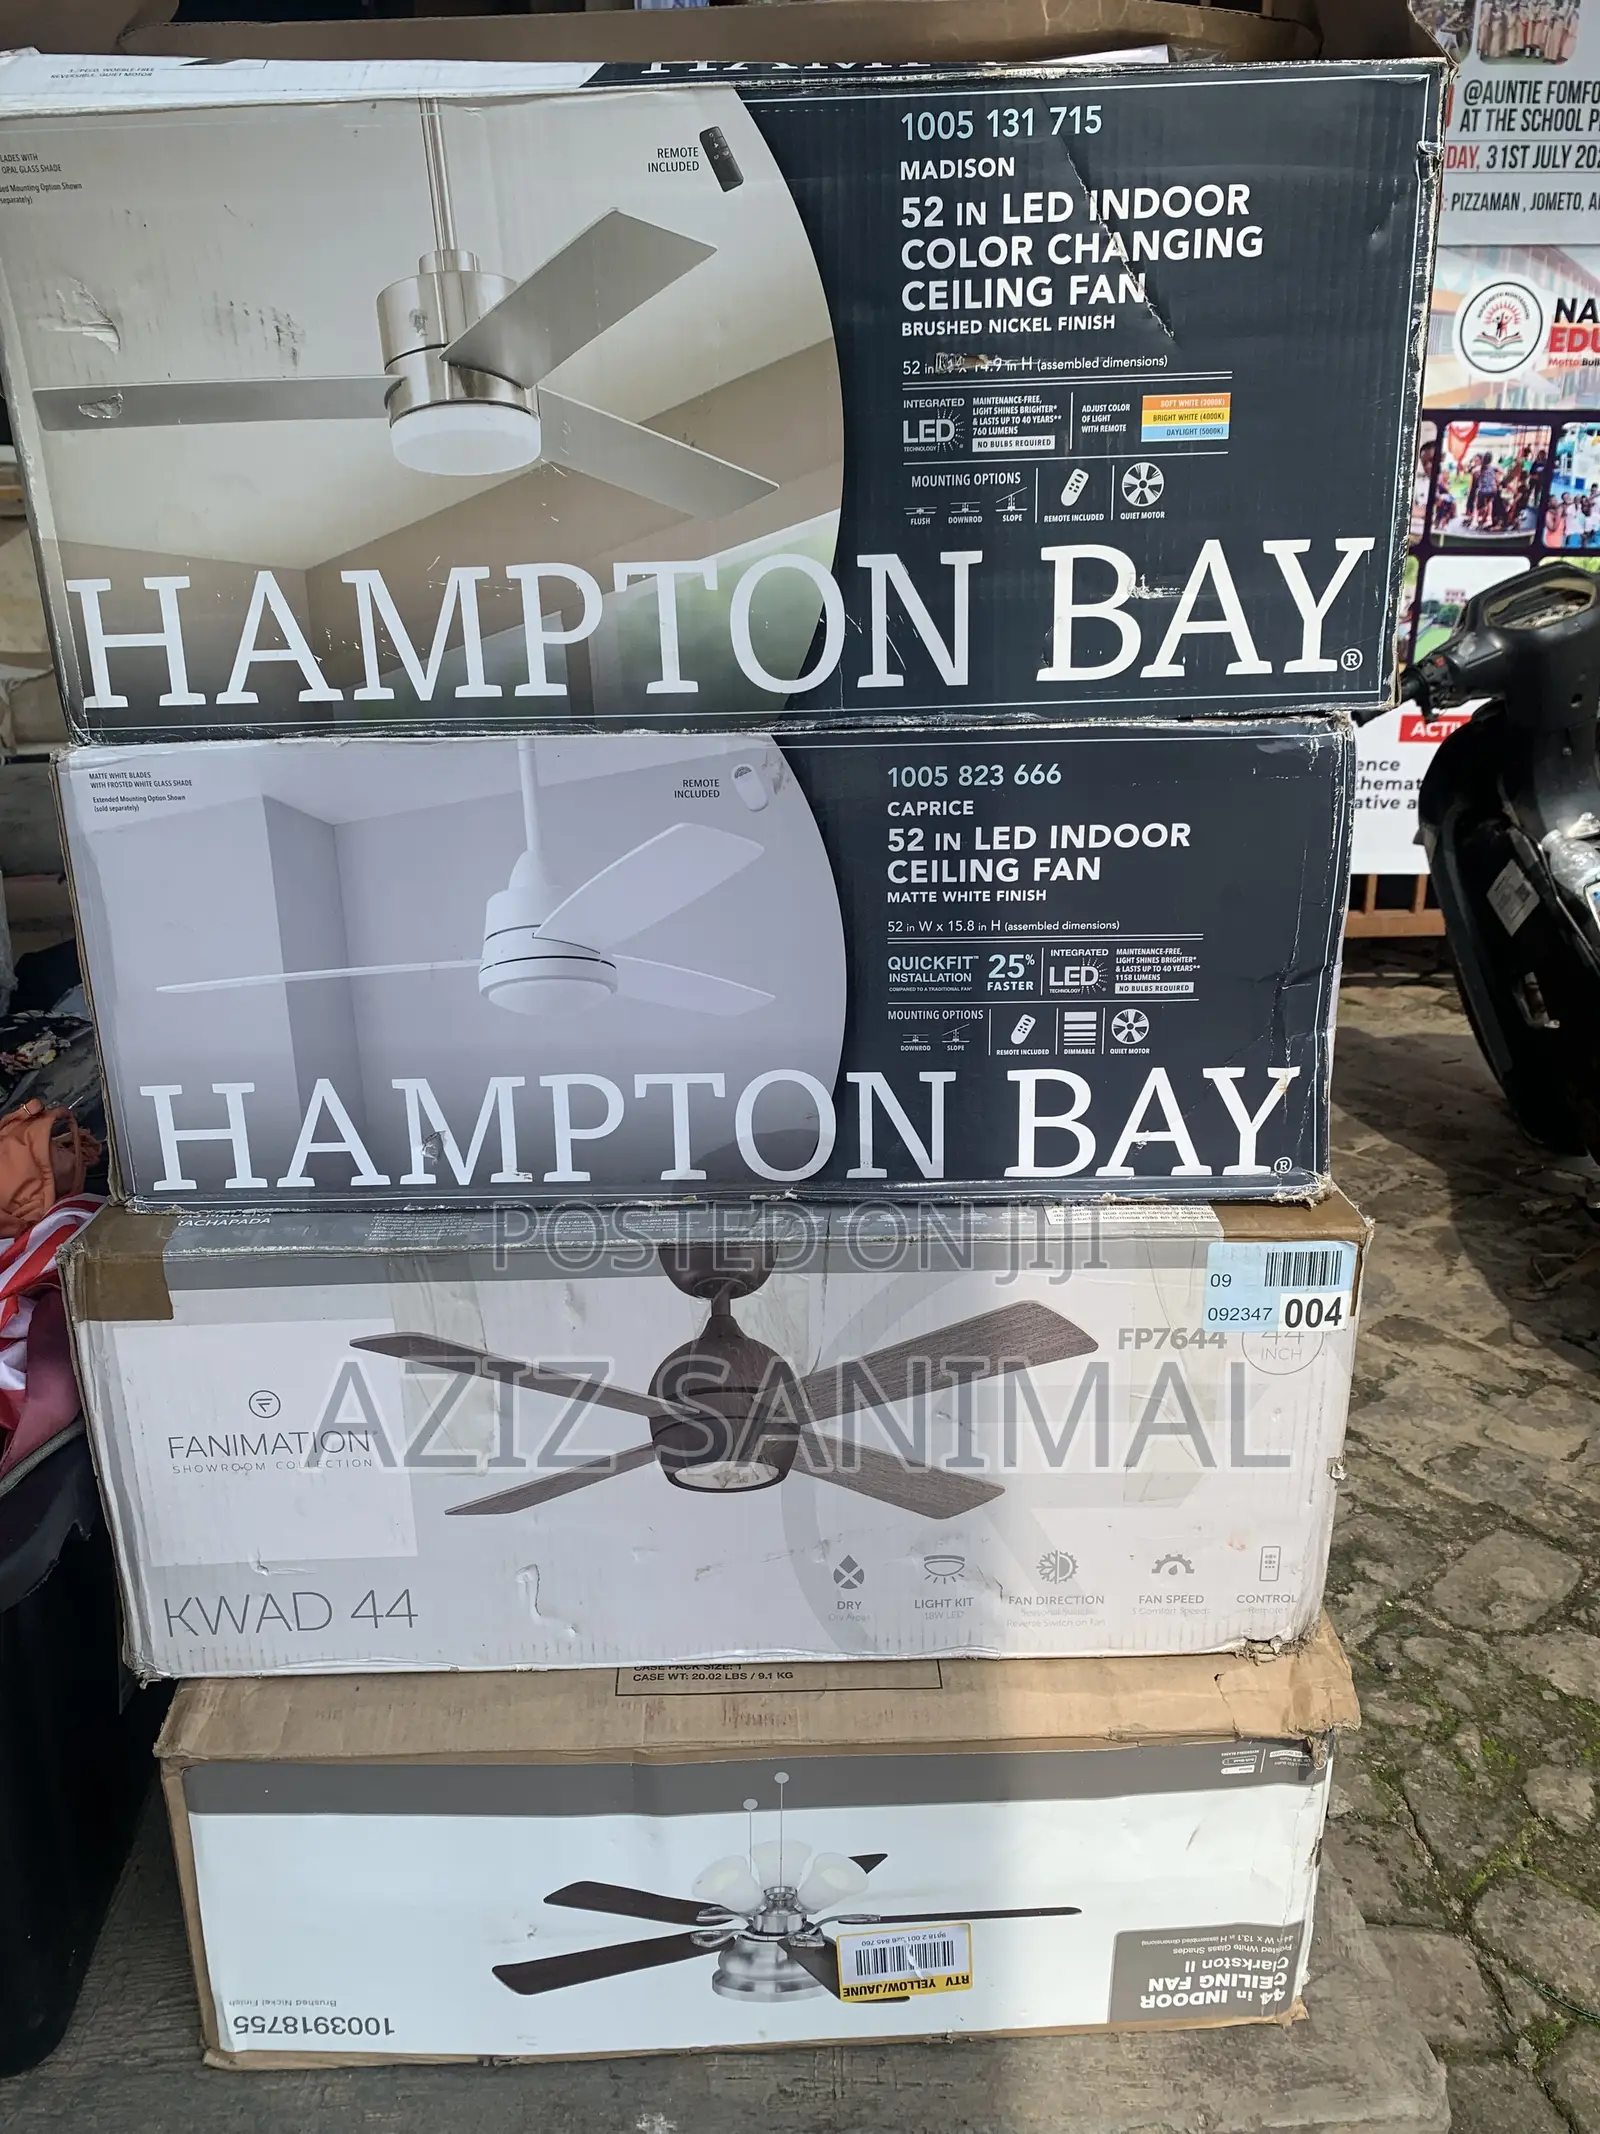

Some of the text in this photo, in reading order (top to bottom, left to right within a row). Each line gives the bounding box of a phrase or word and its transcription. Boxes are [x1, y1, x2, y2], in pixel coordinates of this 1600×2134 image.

[1464, 79, 1543, 106] @AUNTIE
[901, 105, 1103, 141] 1005 131 715
[1459, 108, 1584, 132] AT THE SCHOOL
[657, 147, 699, 159] REMOTE
[1486, 145, 1530, 169] 31ST
[1532, 145, 1572, 169] JULY
[648, 161, 699, 173] INCLUDED
[901, 156, 1015, 181] MADISON
[901, 184, 1250, 229] 52 IN LED INDOOR
[1451, 192, 1520, 212] PIZZAMAN
[901, 225, 1263, 270] COLOR CHANGING
[901, 272, 1147, 312] CEILING FAN
[901, 314, 1116, 337] BRUSHED NICKEL FINISH
[902, 361, 921, 375] 52
[1021, 356, 1033, 371] H
[1037, 355, 1100, 371] (assembled
[1102, 354, 1168, 370] dimensions)
[903, 398, 965, 409] INTEGRATED
[973, 395, 1042, 405] MAINTENANCE-FREE,
[973, 406, 993, 415] LIGHT
[994, 405, 1018, 415] SHINES
[1082, 403, 1131, 413] ADJUST COLOR
[1081, 414, 1111, 423] OF LIGHT
[1153, 413, 1176, 422] BRIGHT
[1178, 413, 1198, 421] WHITE
[903, 419, 956, 443] LED
[973, 426, 1018, 436] 760 LUMENS
[1081, 424, 1126, 433] WITH REMOTE
[1166, 428, 1198, 436] DAYLIGHT
[977, 439, 1052, 449] NO BULBS REQUIRED
[911, 472, 1021, 488] MOUNTING OPTIONS
[911, 517, 931, 525] FLUSH
[948, 516, 983, 524] DOWNROD
[1002, 514, 1023, 522] SLOPE
[1044, 513, 1104, 522] REMOTE INCLUDED
[1120, 511, 1165, 520] QUIET MOTOR
[66, 550, 983, 709] HAMPTON
[1410, 721, 1462, 738] ACTI
[887, 763, 1062, 788] 1005 823 666
[153, 780, 172, 788] GLASS
[173, 779, 192, 787] SHADE
[682, 779, 719, 788] REMOTE
[674, 790, 720, 798] INCLUDED
[887, 800, 974, 817] CAPRICE
[887, 823, 1191, 852] 52 IN LED INDOOR
[887, 856, 1101, 884] CEILING FAN
[887, 889, 1047, 904] MATTE WHITE FINISH
[888, 919, 1120, 933] 52 in W x 15.8 in H (assembled dimensions)
[1050, 949, 1109, 957] INTEGRATED
[988, 953, 1035, 979] 25%
[889, 972, 972, 983] INSTALLATION
[1050, 966, 1099, 986] LED
[986, 981, 1034, 992] FASTER
[887, 1009, 984, 1020] MOUNTING OPTIONS
[140, 1069, 956, 1191] HAMPTON
[1210, 1273, 1232, 1288] 09
[1207, 1297, 1342, 1329] 092347 004
[1118, 1328, 1227, 1350] FP7644
[1260, 1347, 1303, 1361] INCH
[168, 1430, 371, 1459] FANIMATION
[172, 1458, 373, 1475] SHOWROOM COLLECTION
[837, 1600, 862, 1610] DRY
[914, 1597, 975, 1609] LIGHT KIT
[1009, 1595, 1105, 1605] FAN DIRECTION
[1139, 1594, 1205, 1604] FAN SPEED
[1236, 1594, 1298, 1604] CONTROL
[164, 1588, 419, 1638] KWAD 44
[633, 1673, 665, 1682] CASE
[668, 1672, 689, 1682] WT:
[691, 1672, 722, 1682] 20.02
[725, 1671, 748, 1680] LBS
[758, 1671, 773, 1680] 9.1
[776, 1671, 794, 1680] KG
[1202, 1956, 1289, 1973] Clarkston
[843, 1974, 970, 1997] RTV YELLOW/JAUNE
[1149, 1971, 1288, 1992] CEILING FAN
[1140, 1990, 1228, 2009] INDOOR
[1237, 1990, 1253, 2002] in
[234, 2016, 395, 2036] 1003918755
